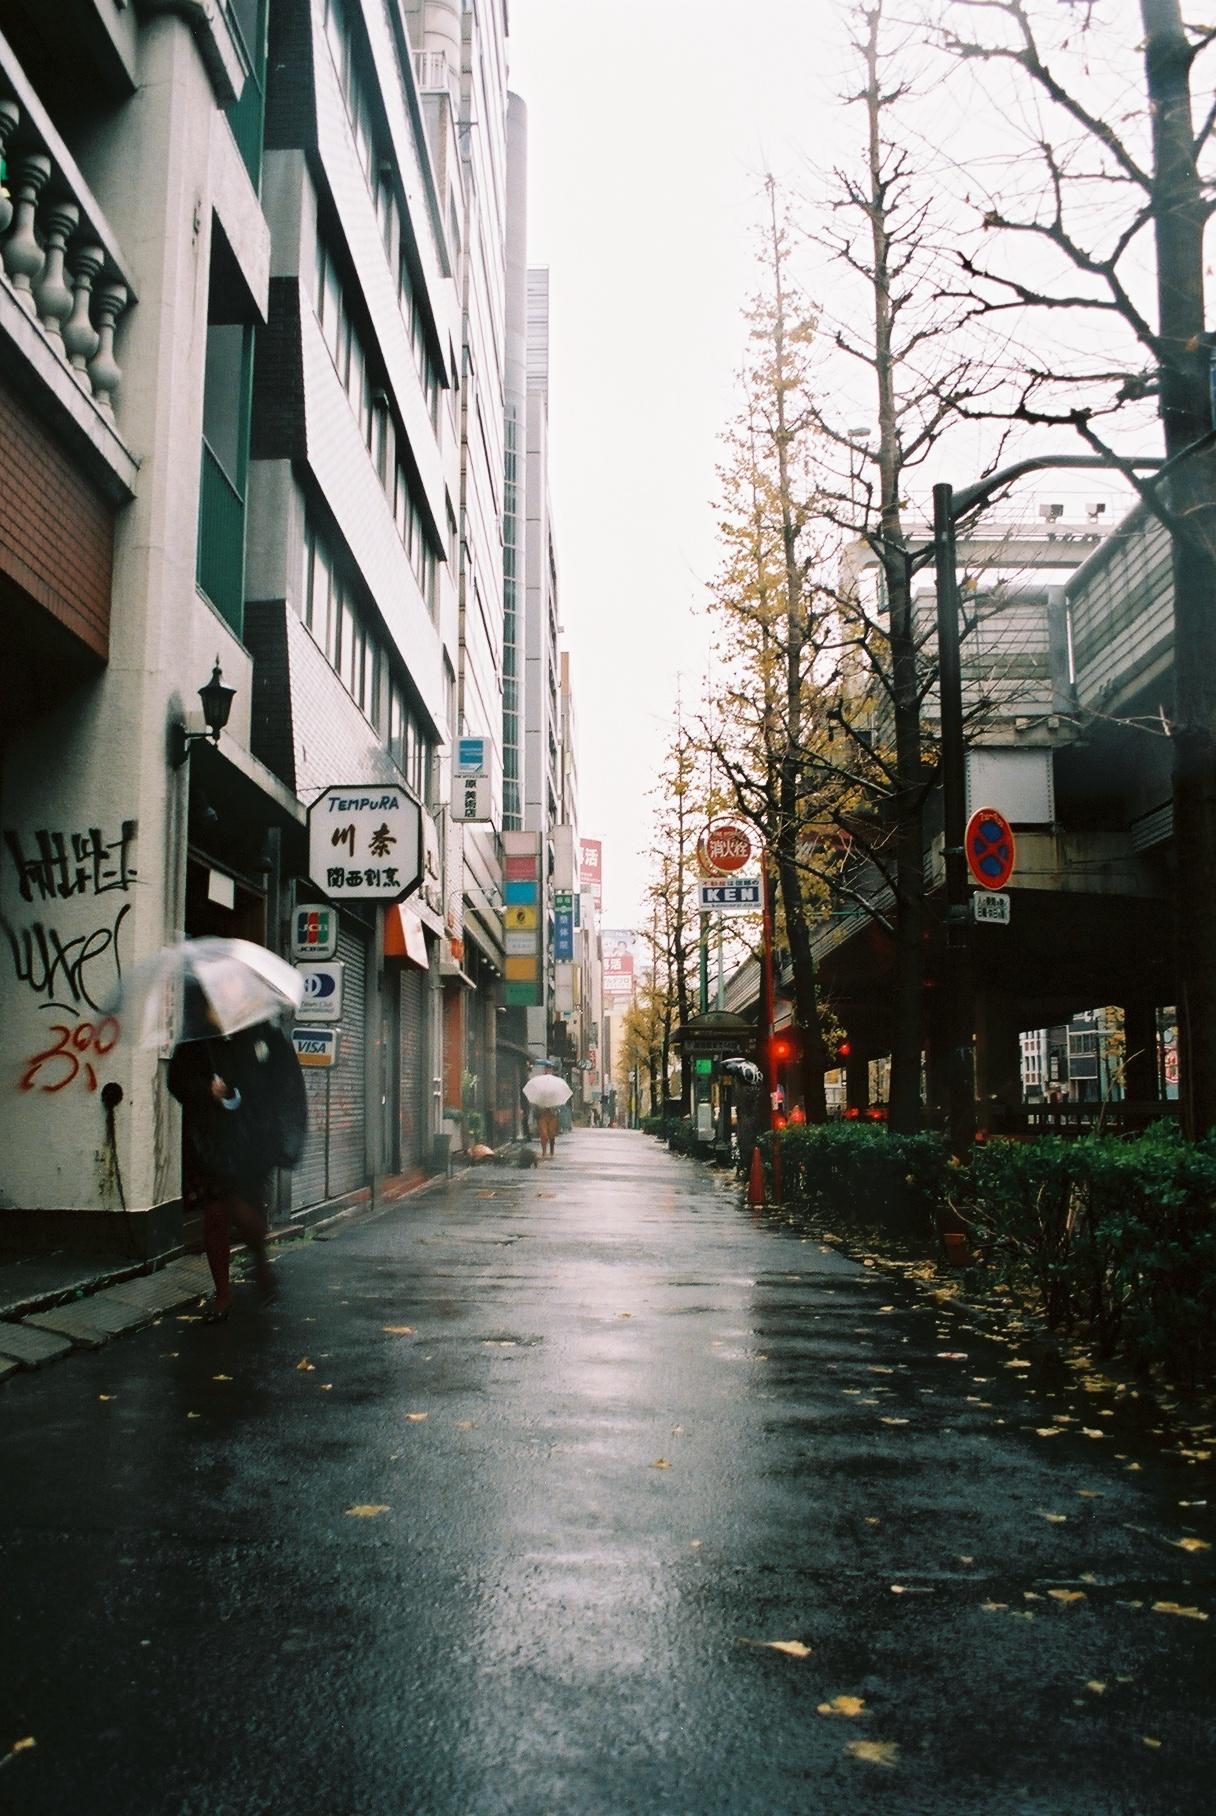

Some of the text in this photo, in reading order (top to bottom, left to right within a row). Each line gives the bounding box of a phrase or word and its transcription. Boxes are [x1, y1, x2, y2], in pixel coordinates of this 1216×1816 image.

[328, 796, 400, 812] TEMPURA
[710, 839, 748, 858] 消火栓
[327, 867, 400, 888] 関西割烹
[707, 888, 754, 902] KEN
[298, 923, 328, 932] JCB
[298, 1041, 327, 1054] VISA
